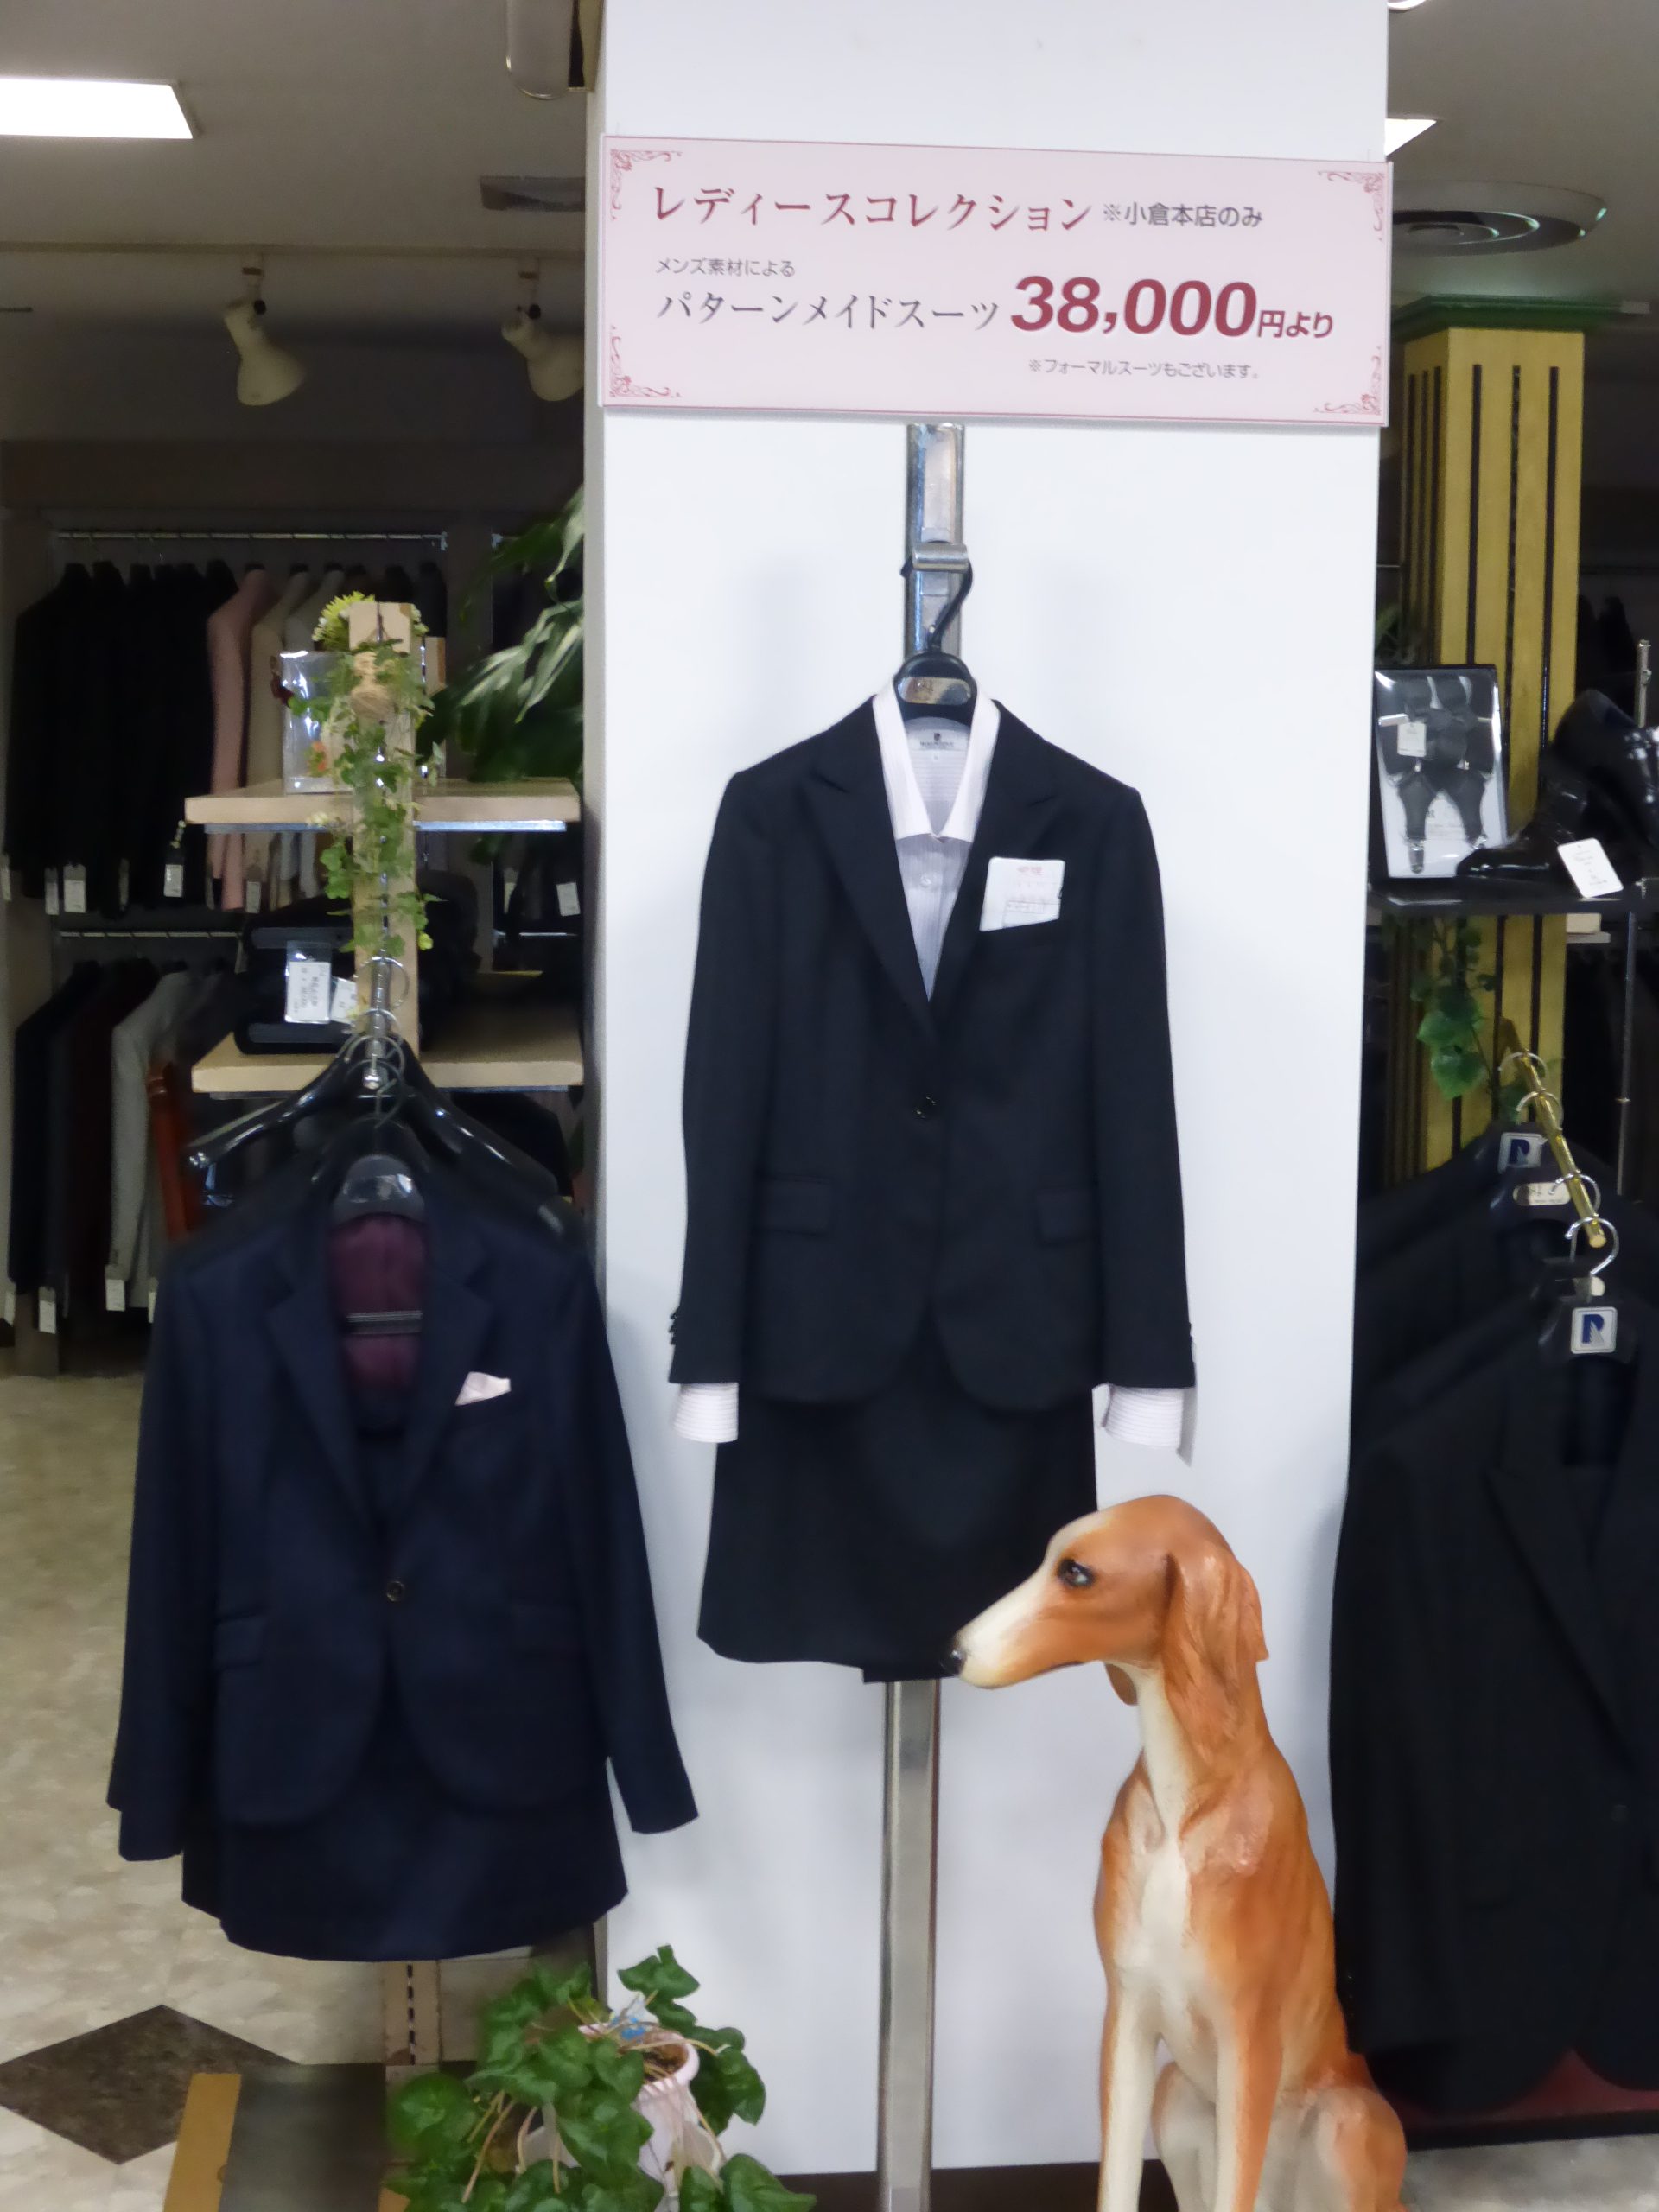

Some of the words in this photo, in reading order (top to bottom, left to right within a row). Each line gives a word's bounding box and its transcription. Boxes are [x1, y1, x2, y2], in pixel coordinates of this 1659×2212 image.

[655, 186, 1092, 231] レディースコレクション
[1103, 201, 1263, 229] ※小倉本店のみ
[655, 257, 796, 277] メンズ素材による
[657, 291, 999, 330] パターンメイドスーツ
